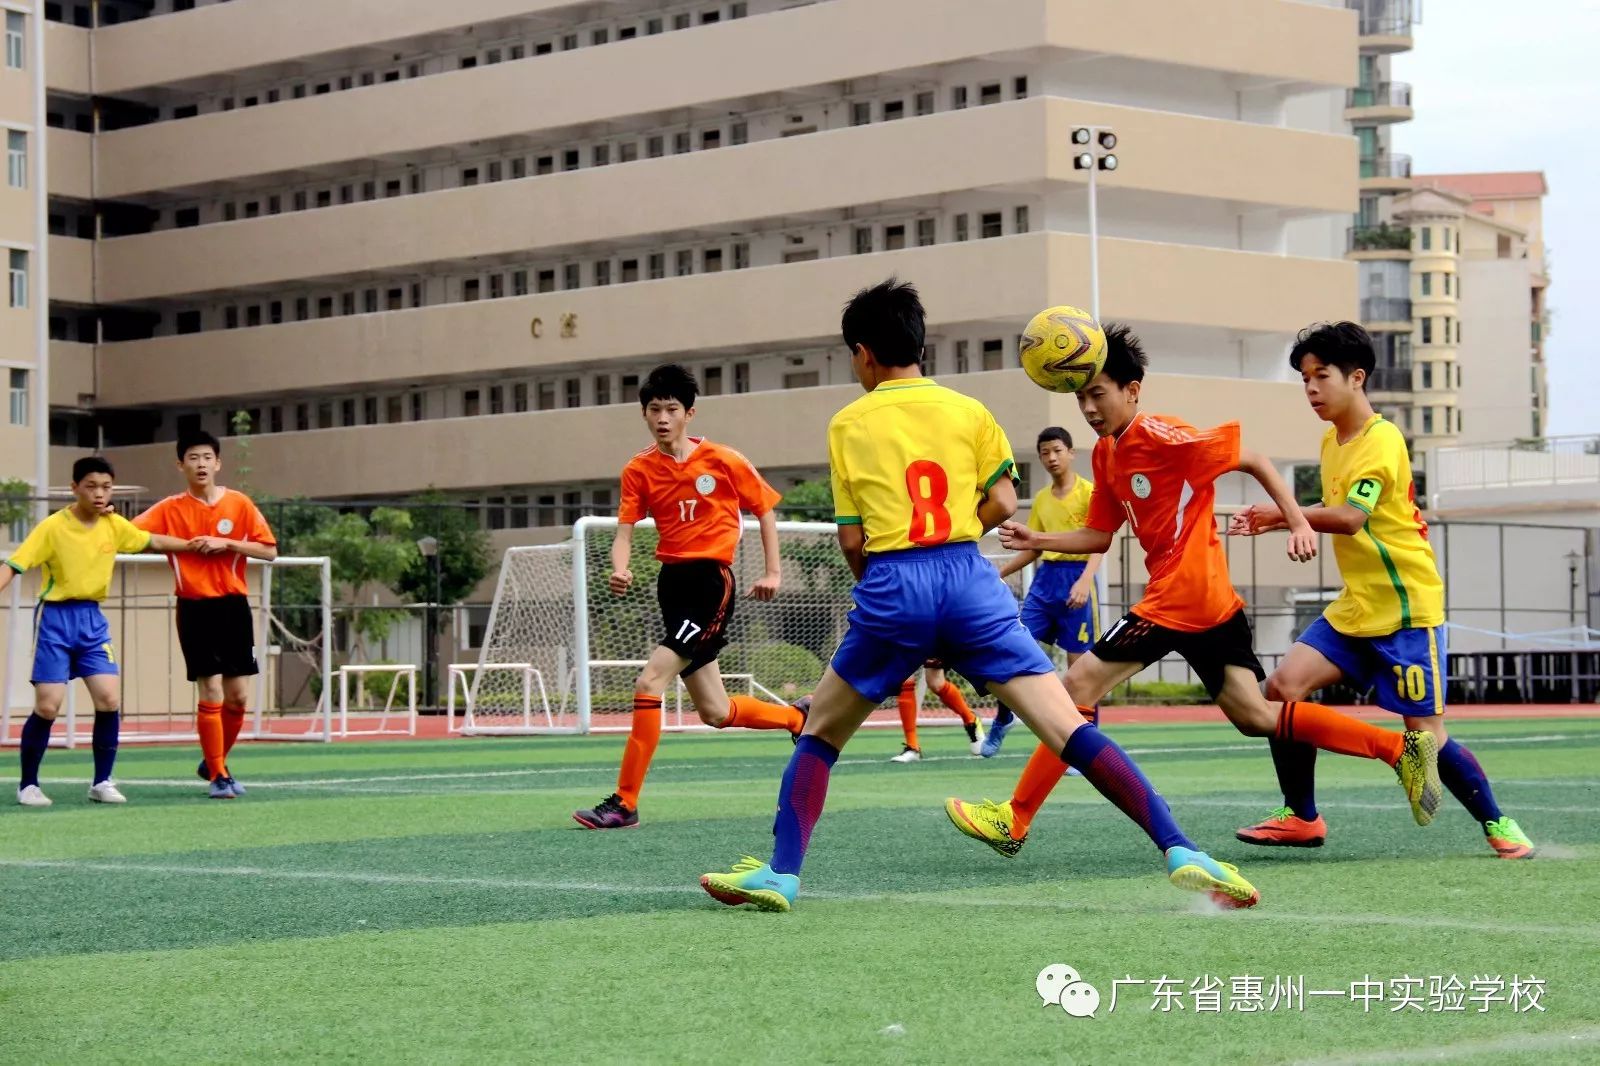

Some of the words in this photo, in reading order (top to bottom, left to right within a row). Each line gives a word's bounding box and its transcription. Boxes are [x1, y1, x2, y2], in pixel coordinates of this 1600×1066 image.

[531, 317, 542, 339] C
[1357, 479, 1374, 497] C
[678, 499, 697, 522] 17
[906, 460, 952, 546] 8
[675, 619, 701, 644] 17
[1077, 622, 1089, 644] 4
[1392, 664, 1425, 702] 10
